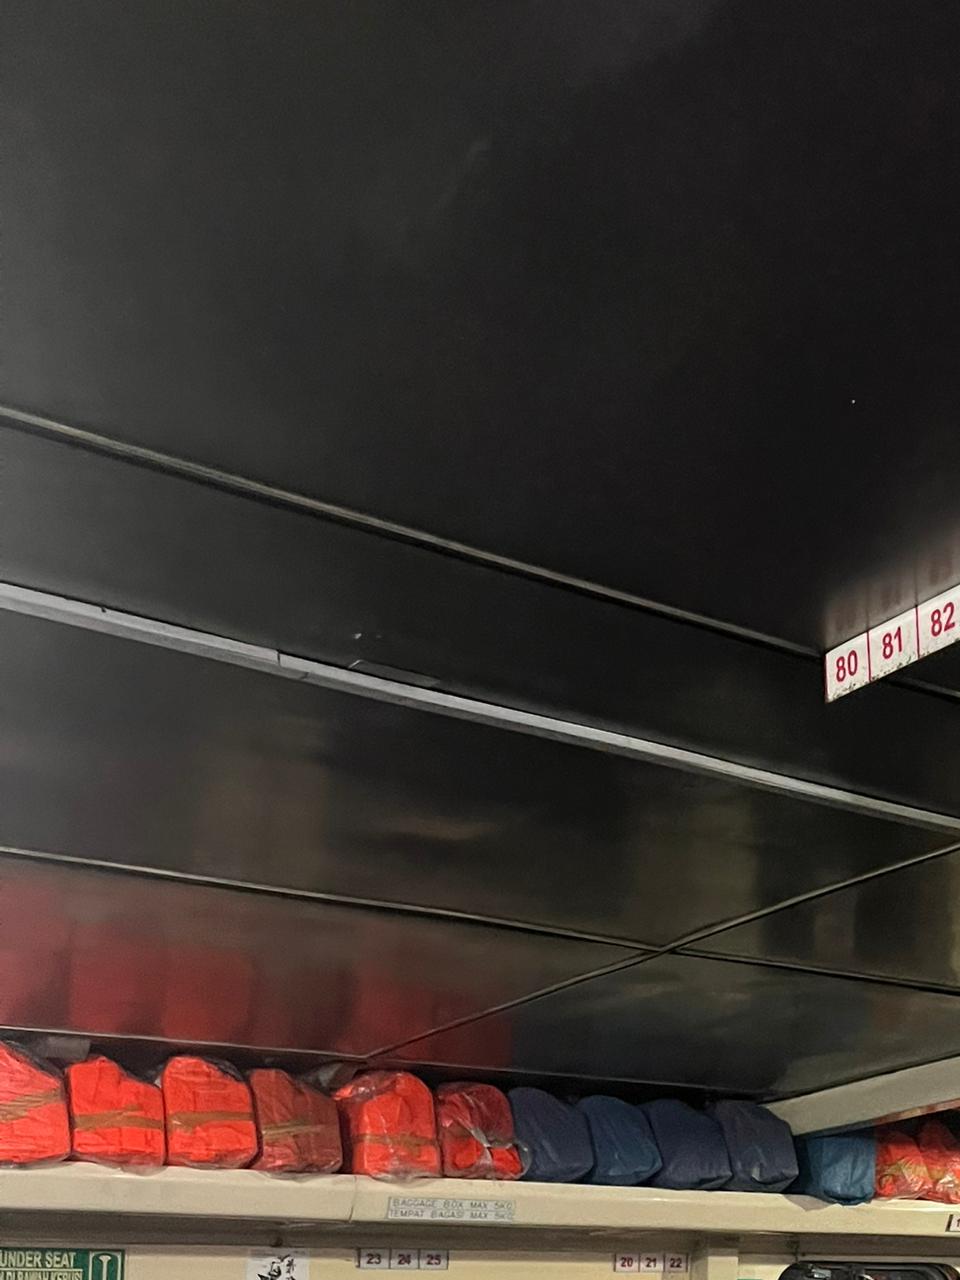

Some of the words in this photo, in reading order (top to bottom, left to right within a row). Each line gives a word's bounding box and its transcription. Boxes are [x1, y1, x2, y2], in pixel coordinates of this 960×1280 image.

[836, 650, 858, 682] 80
[882, 626, 903, 659] 81
[930, 602, 955, 637] 82
[0, 1249, 42, 1268] UNDER
[45, 1251, 76, 1268] SEAT
[366, 1253, 381, 1265] 23
[398, 1254, 411, 1265] 24
[426, 1254, 441, 1265] 25
[621, 1256, 633, 1268] 20
[645, 1257, 657, 1268] 21
[670, 1257, 682, 1268] 22
